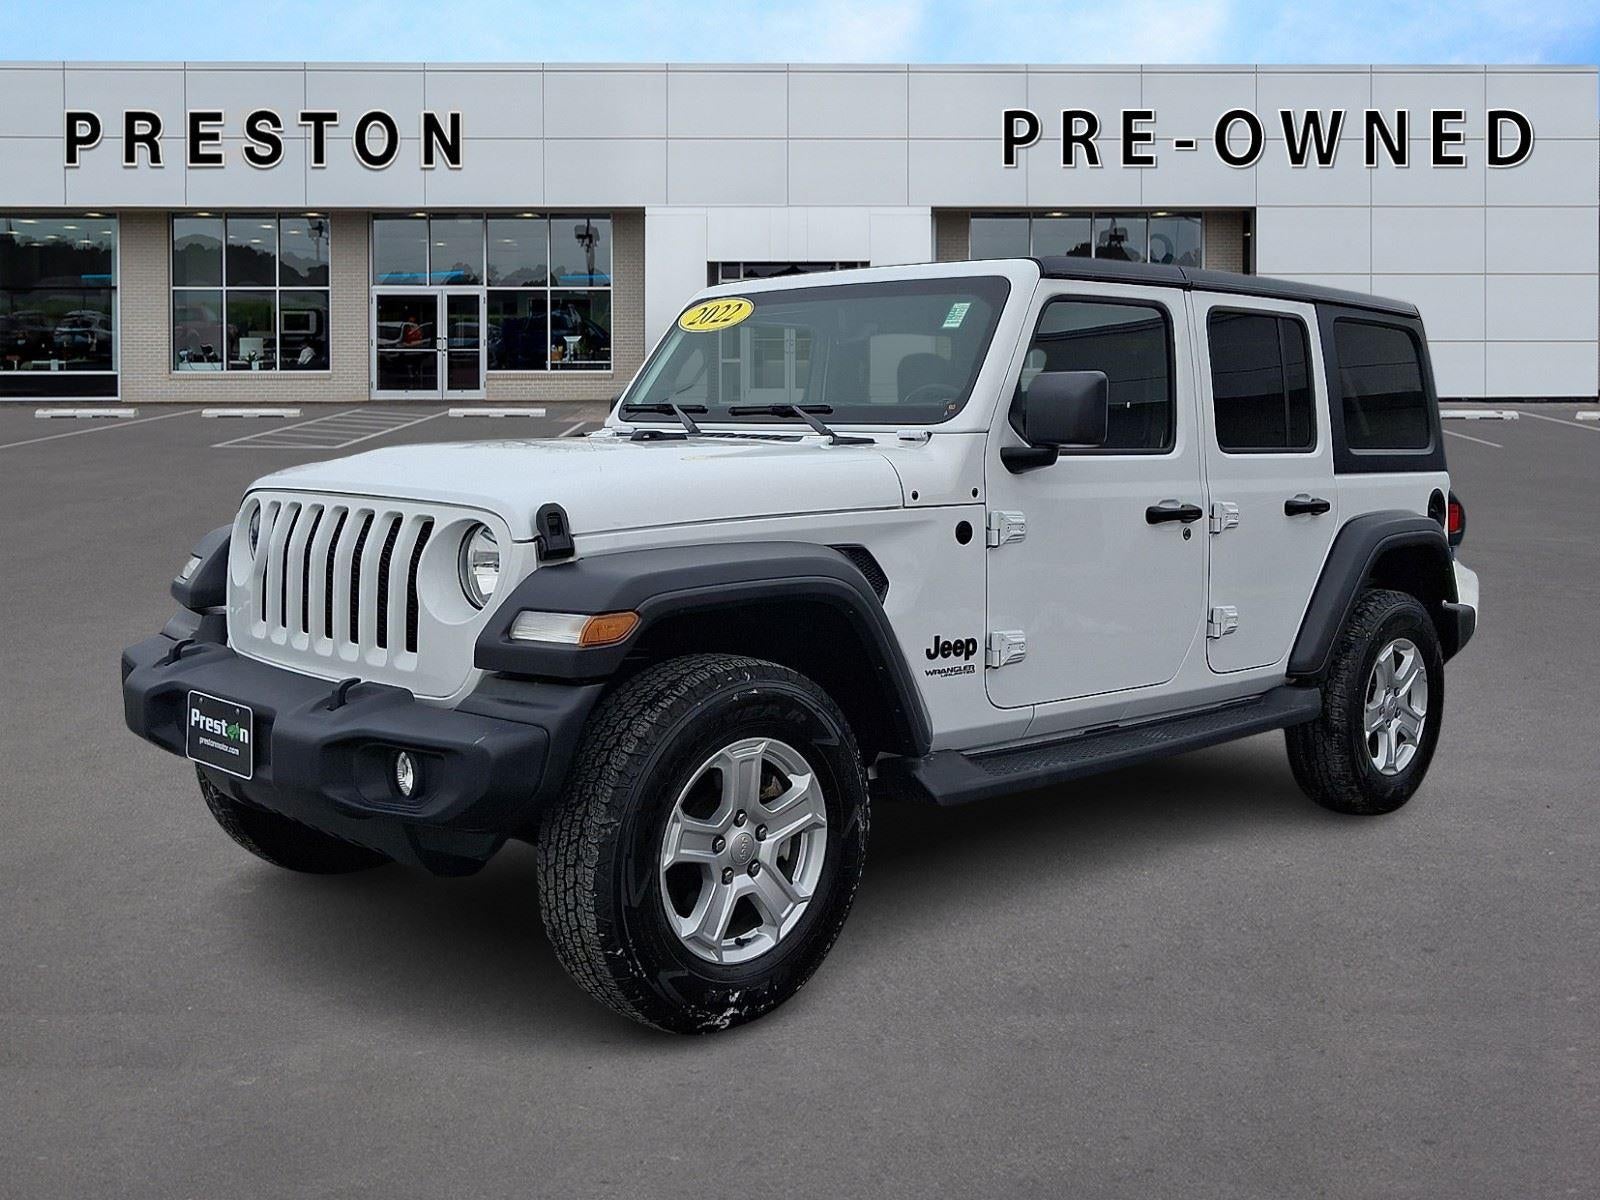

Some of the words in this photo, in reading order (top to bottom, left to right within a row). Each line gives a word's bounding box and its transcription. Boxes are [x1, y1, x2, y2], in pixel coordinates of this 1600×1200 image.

[64, 110, 462, 168] PRESTON
[1002, 109, 1535, 167] PRE-OWNED
[687, 303, 743, 325] 2022
[925, 635, 978, 661] Jeep
[924, 664, 976, 676] WRANGLER
[190, 708, 249, 743] Preston
